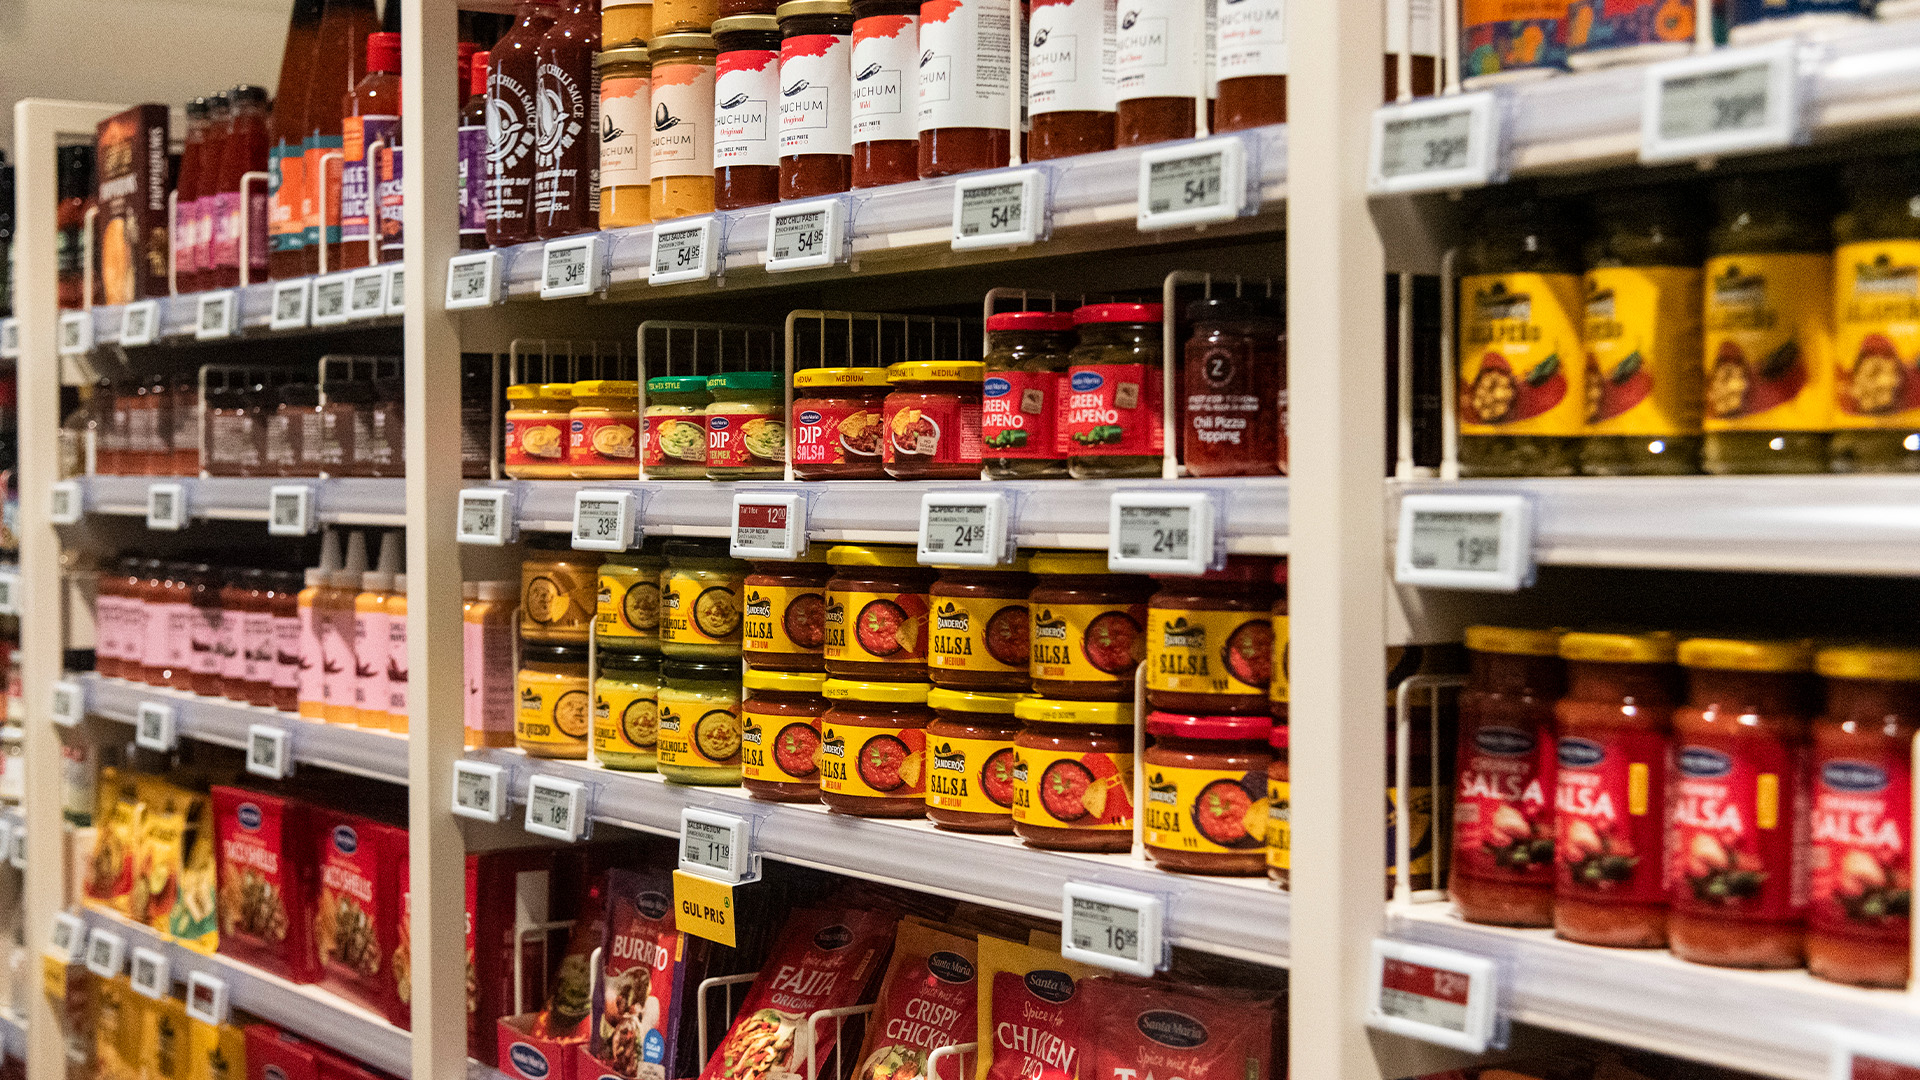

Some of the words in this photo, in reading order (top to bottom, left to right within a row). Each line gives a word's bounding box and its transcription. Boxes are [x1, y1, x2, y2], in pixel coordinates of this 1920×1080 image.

[1118, 35, 1161, 49] UCHUM
[1030, 51, 1071, 66] UCHUM
[920, 72, 946, 85] CHUM
[547, 64, 572, 86] CHILLI
[567, 83, 584, 118] SAUCE
[499, 74, 526, 97] CHILLI
[521, 95, 537, 128] SAUCE
[784, 114, 805, 125] Original
[720, 127, 744, 137] Original
[1183, 179, 1206, 205] 54
[802, 214, 819, 223] PASTE
[990, 205, 1009, 228] 54
[798, 231, 813, 252] 54
[813, 230, 823, 242] 95
[677, 247, 690, 266] 54
[691, 246, 700, 256] 95
[565, 265, 577, 282] 34
[714, 378, 727, 386] STYLE
[835, 374, 864, 382] MEDIUM
[930, 369, 961, 377] MEDIUM
[1069, 394, 1103, 408] GREEN
[1193, 416, 1213, 429] Chili
[1214, 416, 1247, 429] Pizza
[709, 431, 730, 448] DIP
[799, 426, 822, 444] DIP
[1197, 429, 1241, 444] Topping
[718, 450, 731, 459] MEX
[796, 444, 825, 460] SALSA
[767, 508, 778, 523] 12
[778, 508, 786, 518] 00
[597, 518, 610, 535] 33
[954, 525, 972, 547] 24
[1152, 529, 1174, 553] 24
[746, 605, 771, 618] BANDEROS
[825, 610, 844, 625] NDEROS
[745, 621, 773, 640] SALSA
[937, 616, 969, 632] BANDEROS
[1035, 623, 1067, 640] BANDEROS
[751, 641, 769, 650] MEDIUM
[934, 635, 972, 656] SALSA
[1033, 644, 1071, 665] SALSA
[944, 656, 966, 667] MEDIUM
[1159, 653, 1210, 677] SALSA
[822, 741, 845, 758] BANDEROS
[934, 755, 965, 773] BANDEROS
[826, 780, 842, 791] MEDIUM
[931, 774, 968, 797] SALSA
[1461, 770, 1545, 805] SALSA
[940, 796, 962, 807] MEDIUM
[1014, 788, 1030, 809] LSA
[1554, 785, 1616, 819] ALSA
[550, 806, 561, 824] 18
[1674, 800, 1744, 833] ALSA
[708, 842, 720, 862] 11
[721, 844, 730, 857] 19
[682, 900, 702, 919] GUL
[703, 906, 725, 925] PRIS
[1106, 926, 1125, 951] 16
[613, 934, 668, 971] BURRITO
[931, 955, 951, 970] Santa
[951, 960, 971, 975] Maria
[770, 965, 839, 996] FAJITA
[1030, 972, 1058, 990] Santa
[905, 997, 962, 1031] CRISPY
[1022, 1000, 1047, 1023] Spice
[1142, 1016, 1172, 1034] Santa
[1172, 1022, 1202, 1040] Maria
[886, 1017, 960, 1060] CHICKEN
